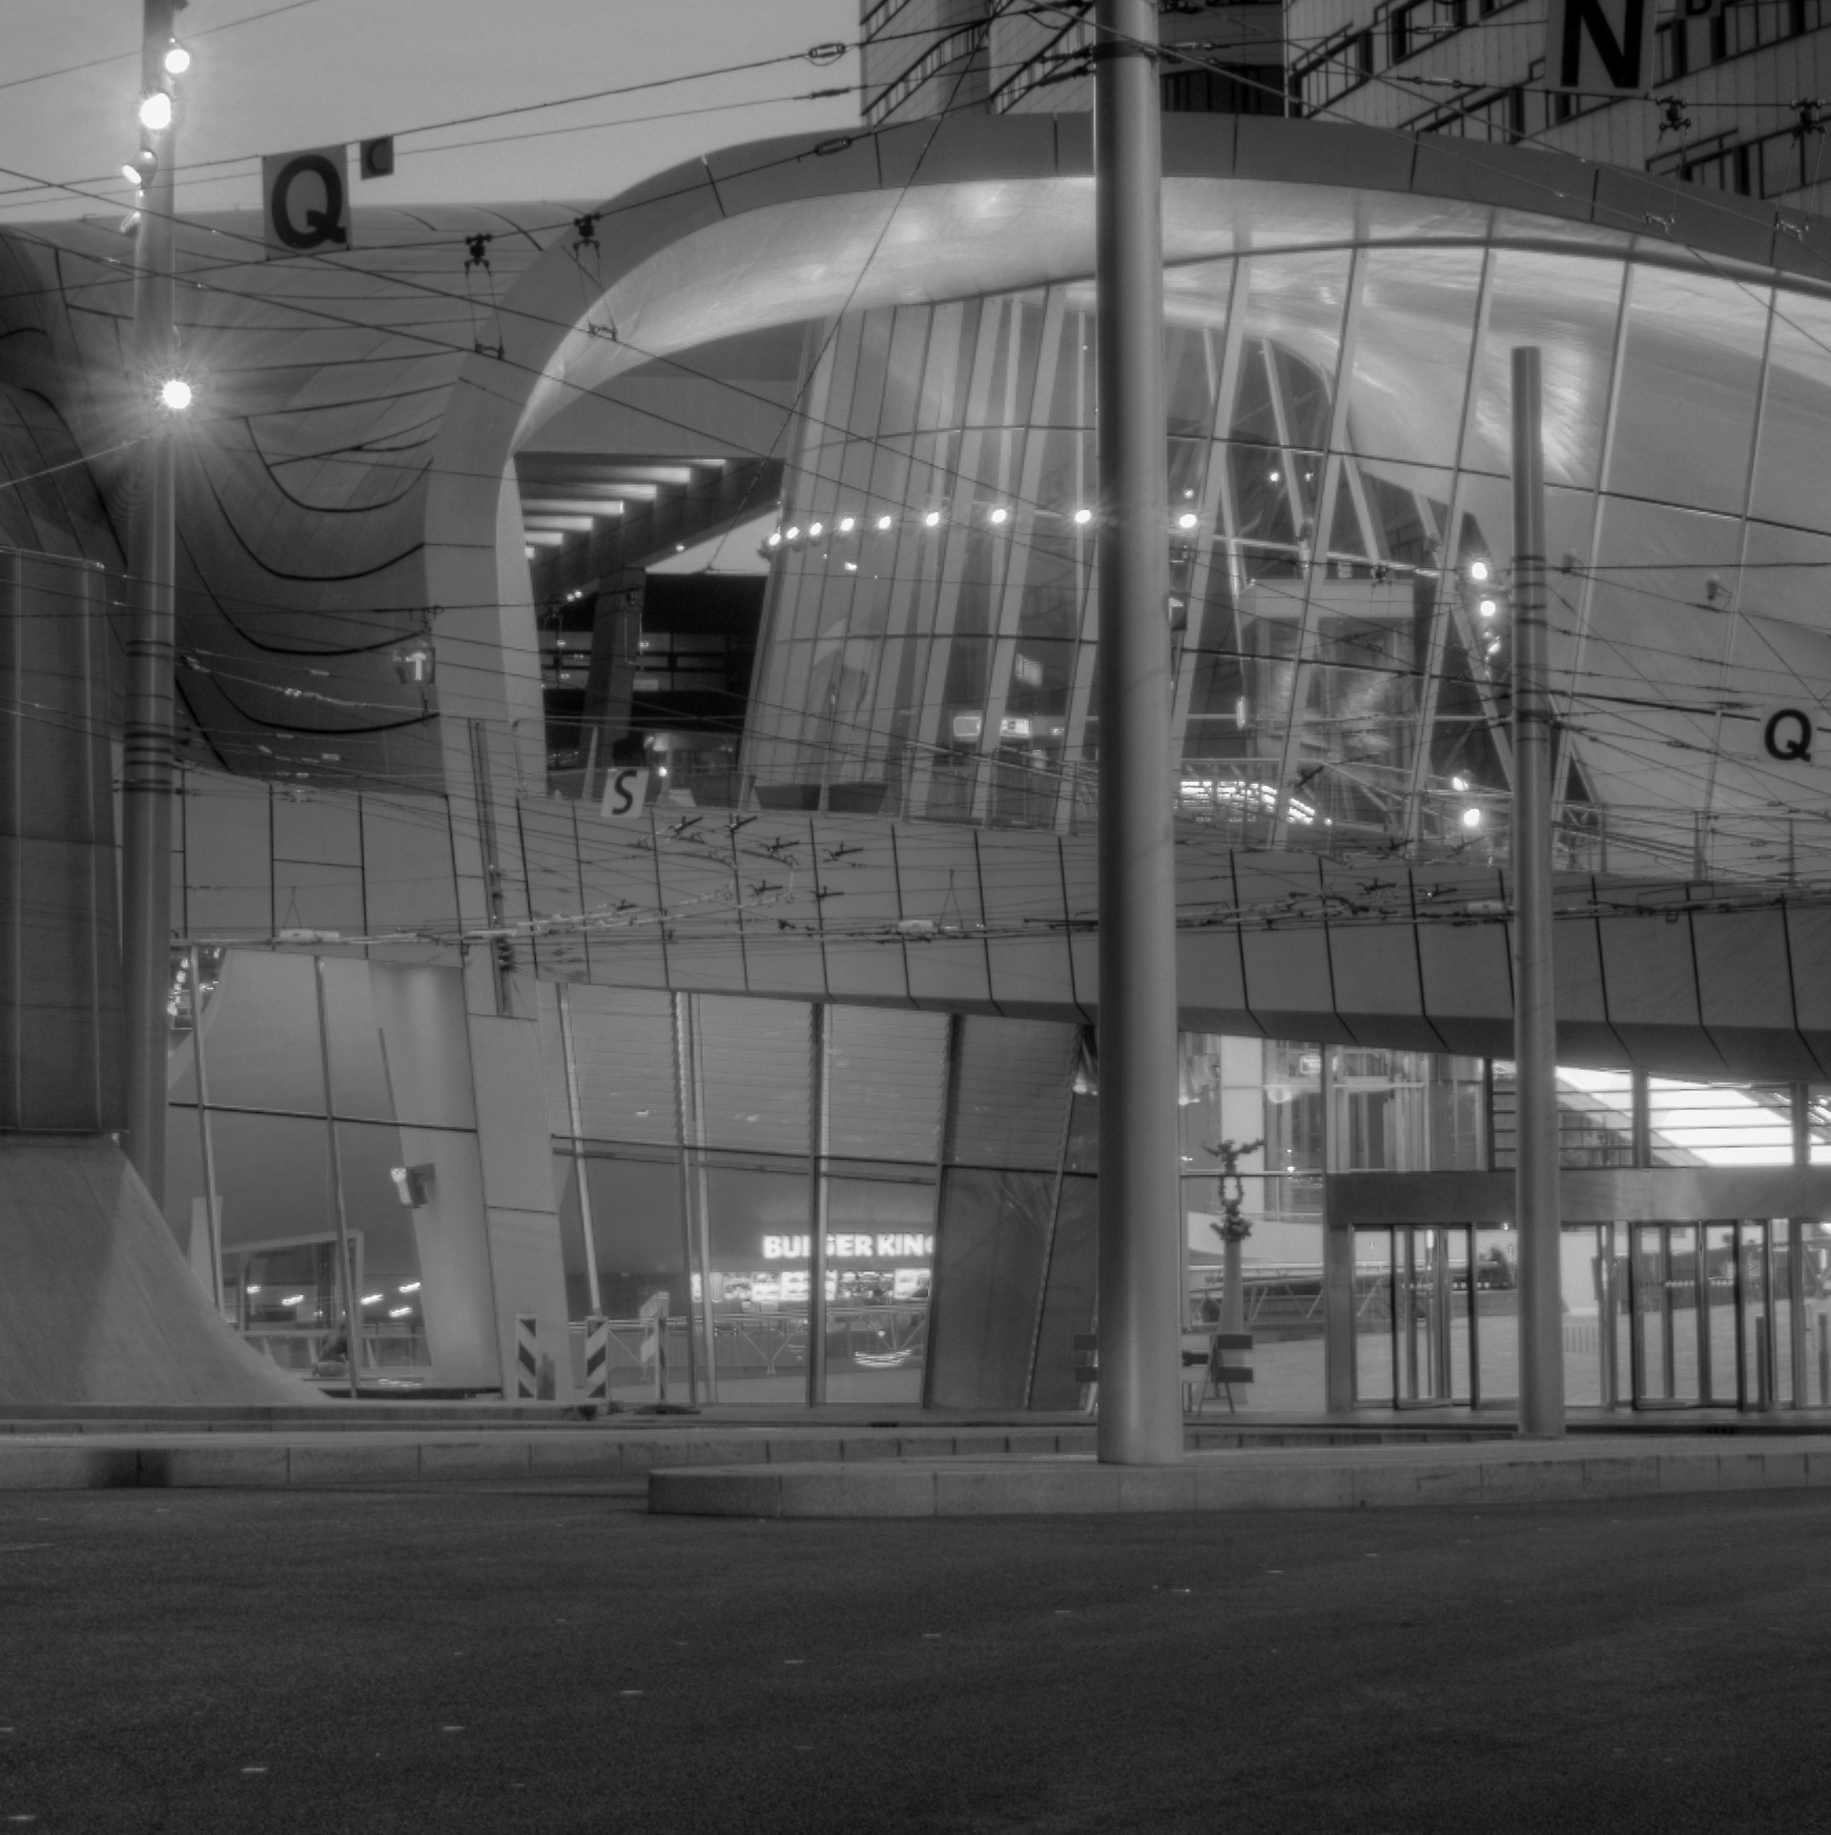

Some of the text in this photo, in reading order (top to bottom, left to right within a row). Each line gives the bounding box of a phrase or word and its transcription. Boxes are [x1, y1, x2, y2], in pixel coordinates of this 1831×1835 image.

[366, 138, 389, 175] C
[271, 154, 347, 250] Q
[1763, 708, 1812, 763] Q
[611, 770, 638, 815] S
